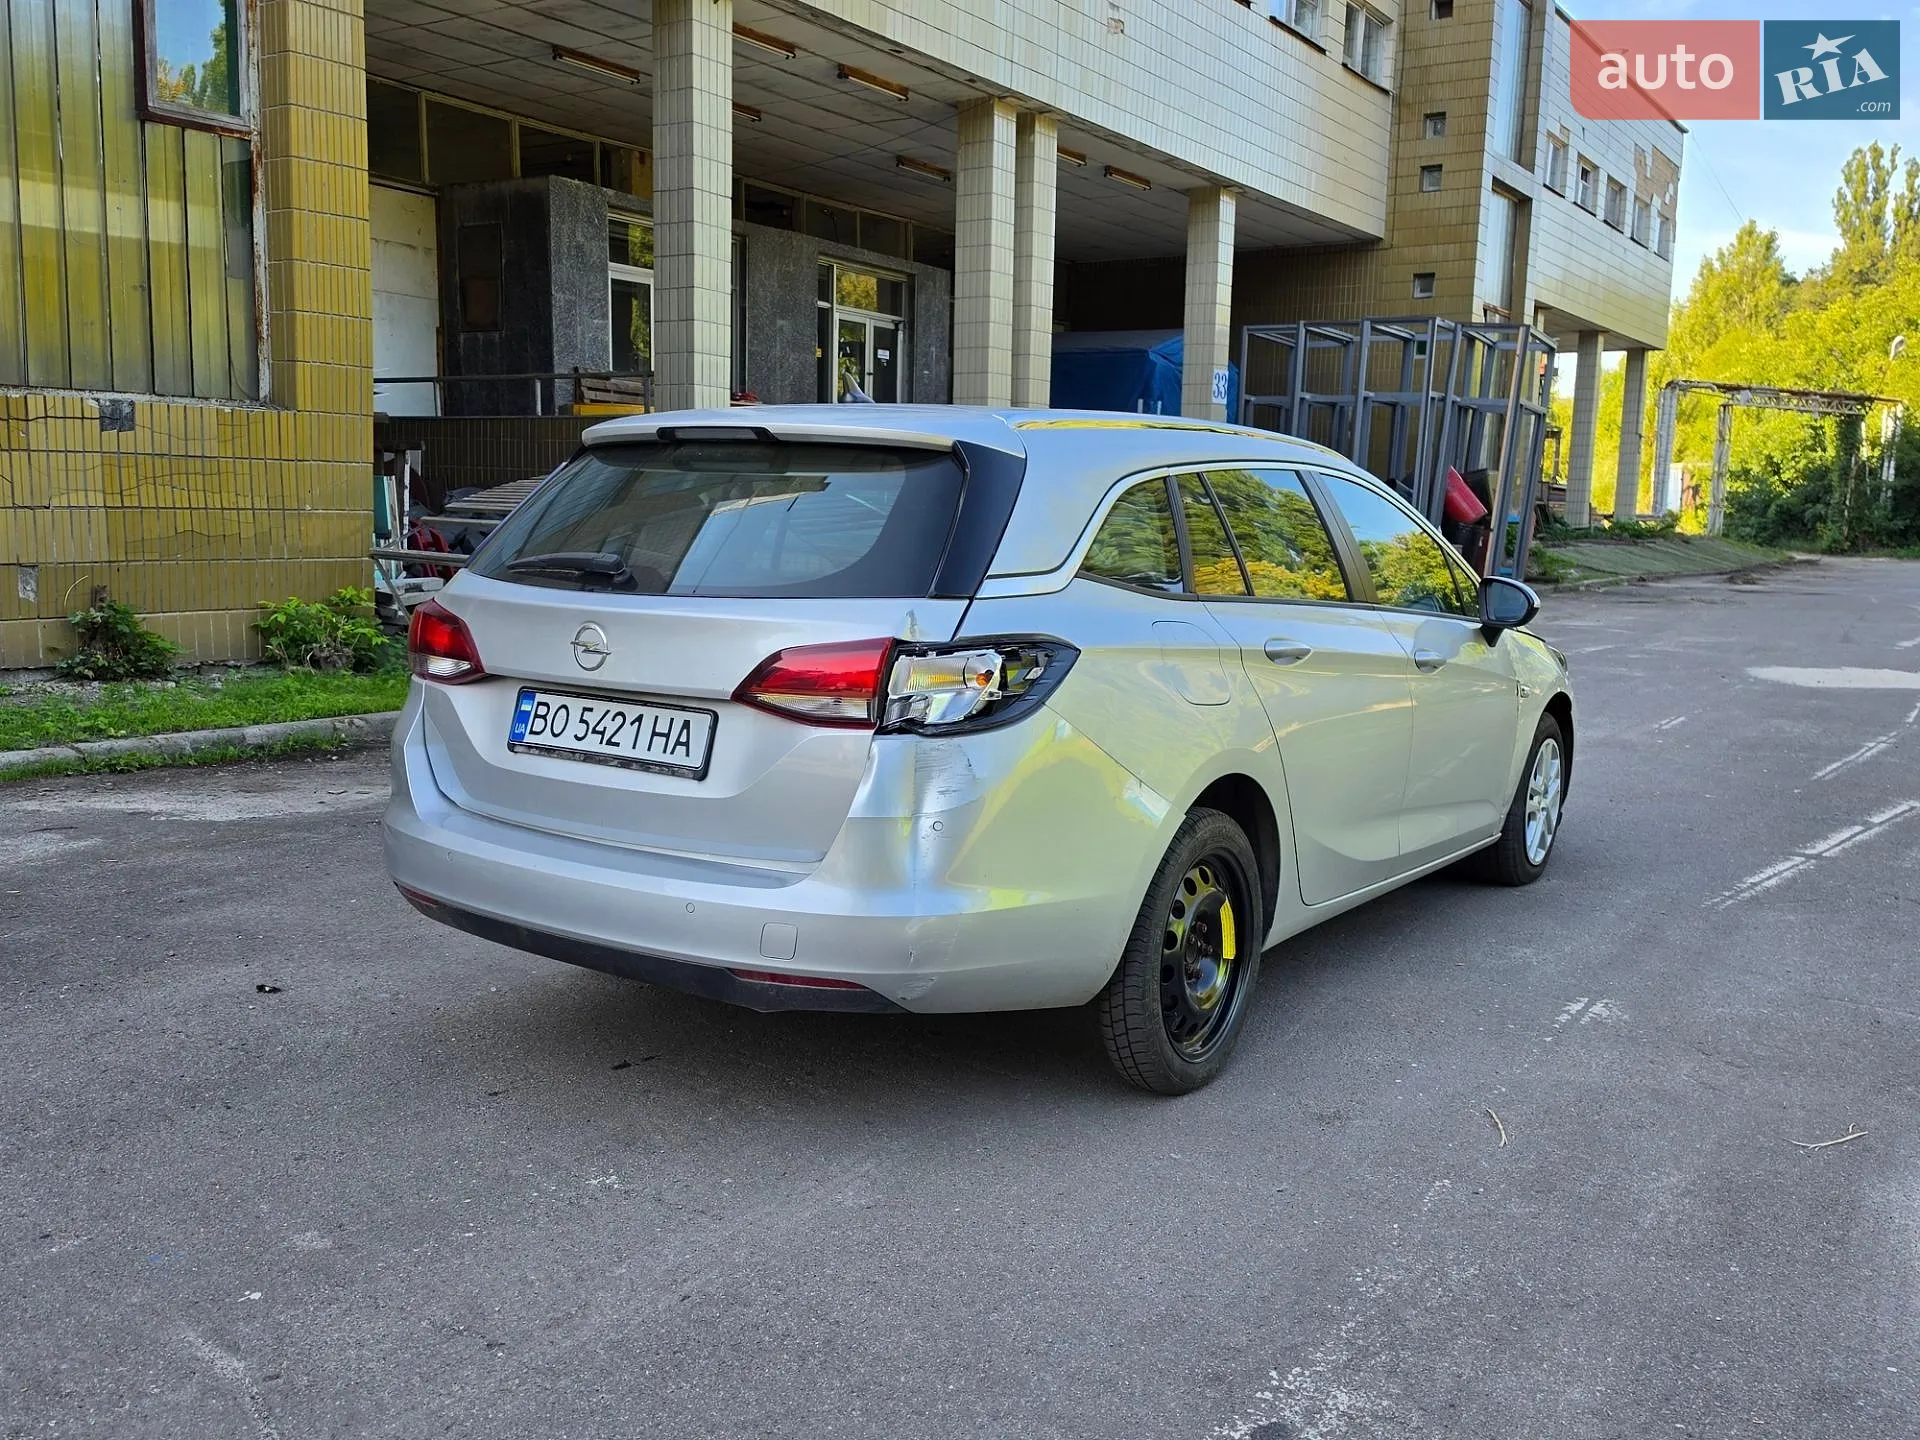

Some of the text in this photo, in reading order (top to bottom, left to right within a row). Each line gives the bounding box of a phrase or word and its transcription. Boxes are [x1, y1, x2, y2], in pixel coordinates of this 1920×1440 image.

[1213, 372, 1227, 400] 33
[514, 722, 526, 735] UA
[528, 701, 691, 758] BO 5421 HA
